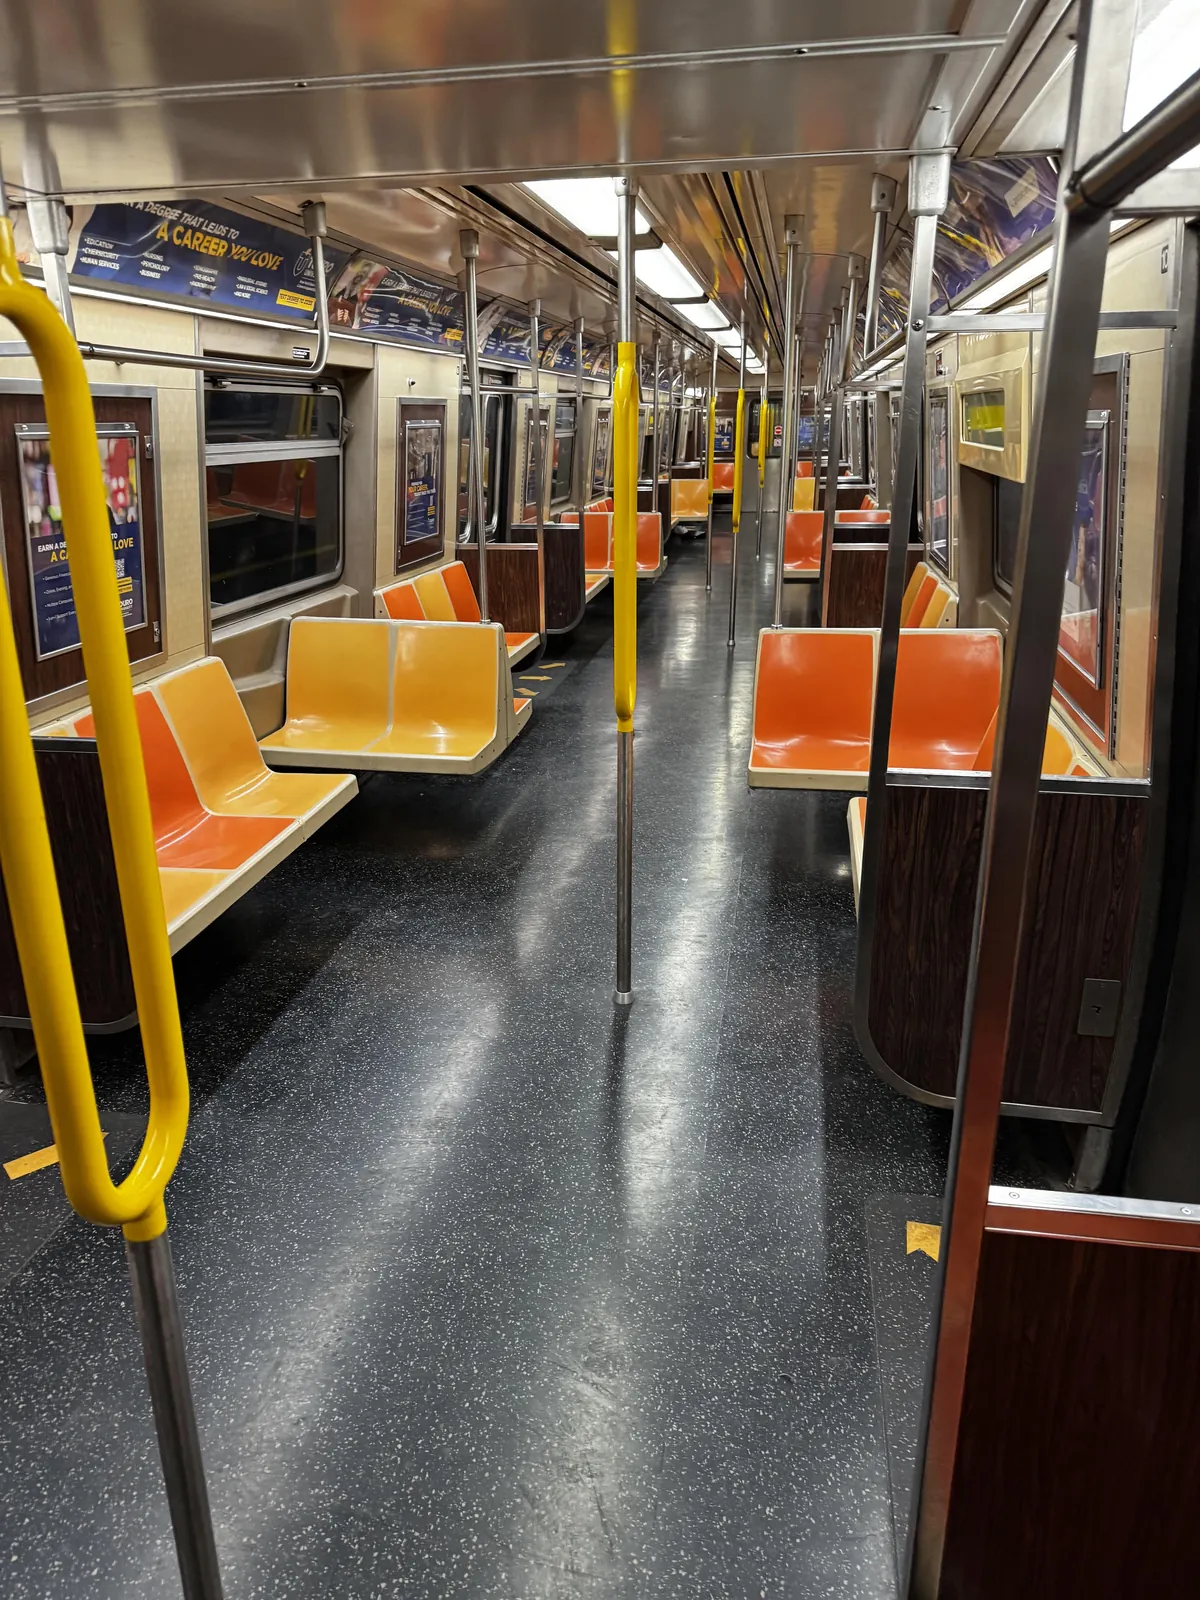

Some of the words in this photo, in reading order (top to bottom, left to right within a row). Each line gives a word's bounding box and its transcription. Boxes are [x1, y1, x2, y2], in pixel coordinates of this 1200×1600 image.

[144, 201, 182, 220] DEGREE
[180, 212, 204, 228] THAT
[201, 220, 229, 237] LEADS
[227, 228, 240, 240] TO
[156, 220, 169, 242] A
[172, 225, 229, 257] CAREER
[228, 242, 254, 262] YOU
[250, 250, 284, 271] LOVE
[38, 544, 54, 553] EARN
[50, 551, 58, 562] A
[114, 537, 134, 550] LOVE
[120, 598, 134, 608] URO
